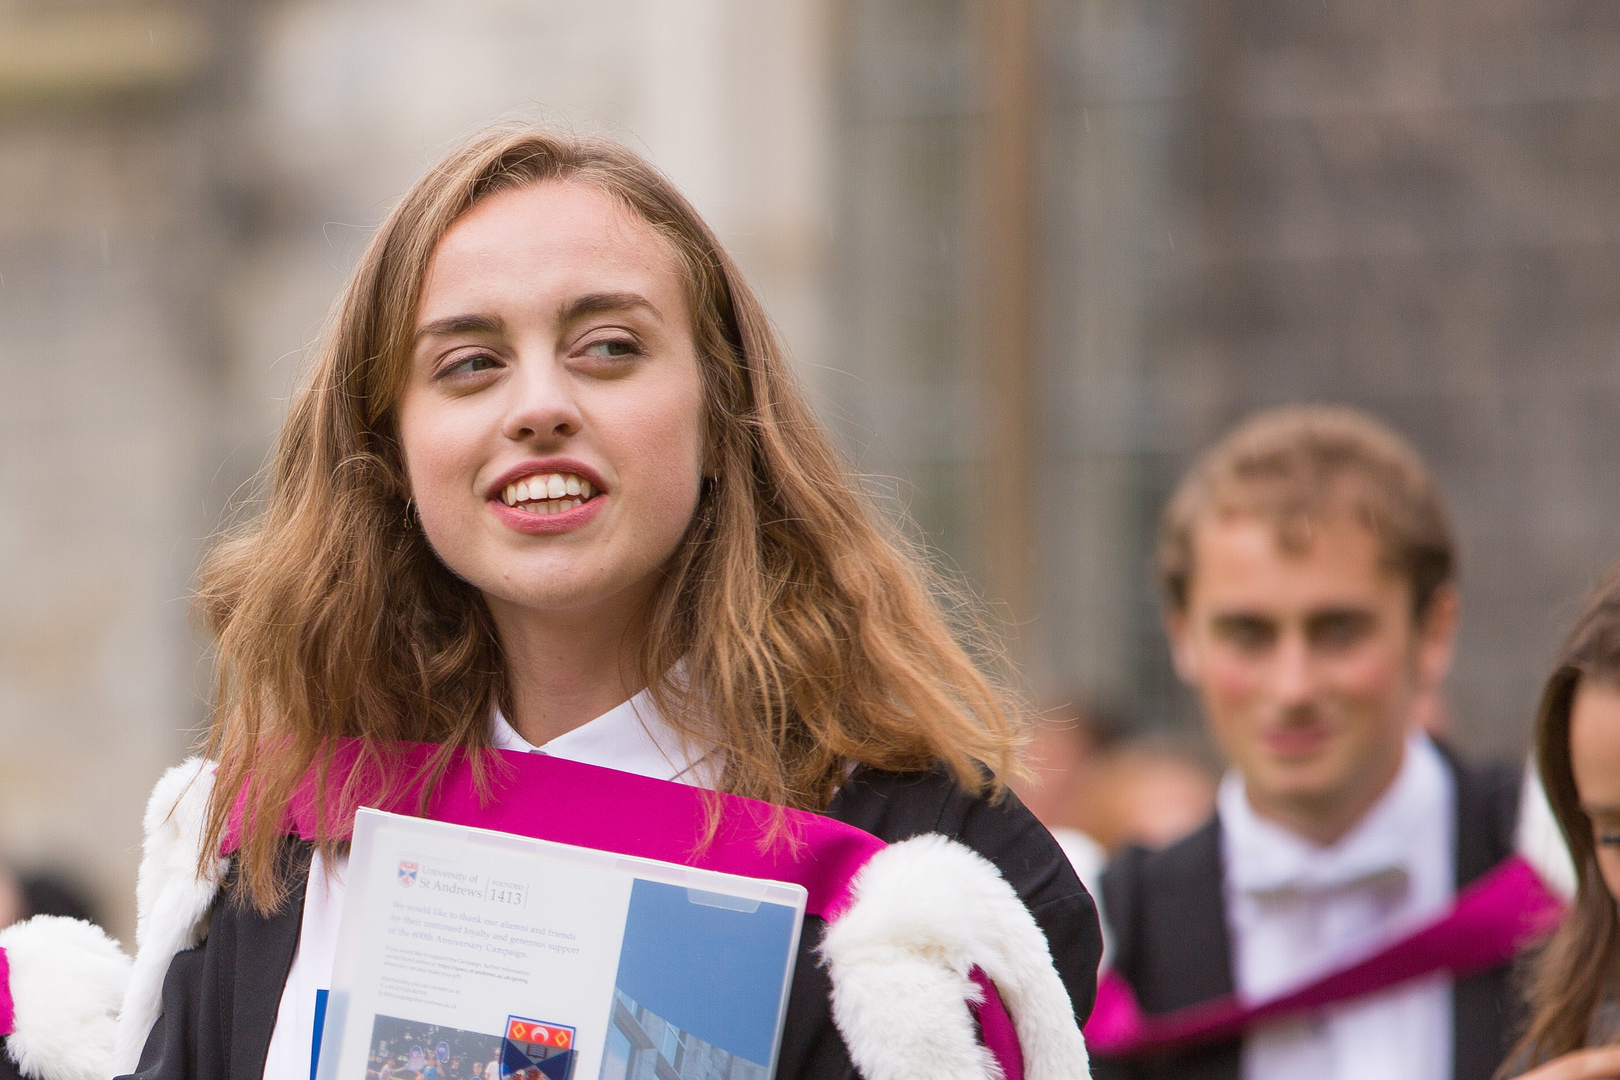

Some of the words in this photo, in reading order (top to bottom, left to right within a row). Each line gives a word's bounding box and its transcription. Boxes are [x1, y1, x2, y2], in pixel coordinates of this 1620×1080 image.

[422, 865, 467, 883] University
[469, 875, 478, 883] of
[420, 877, 430, 888] St
[433, 880, 483, 898] Andrews
[492, 880, 524, 890] FOUNDED
[490, 889, 522, 905] 1413
[392, 901, 404, 909] We
[433, 908, 447, 917] like
[459, 913, 482, 923] thank
[500, 922, 529, 931] alumni
[548, 929, 575, 940] friends
[398, 929, 410, 937] the
[412, 931, 433, 941] 600th
[436, 936, 482, 952] Anniversary
[486, 944, 526, 959] Campaign.
[404, 917, 421, 925] their
[424, 923, 462, 933] continued
[465, 928, 490, 940] loyalty
[510, 938, 545, 947] generous
[548, 945, 579, 954] support
